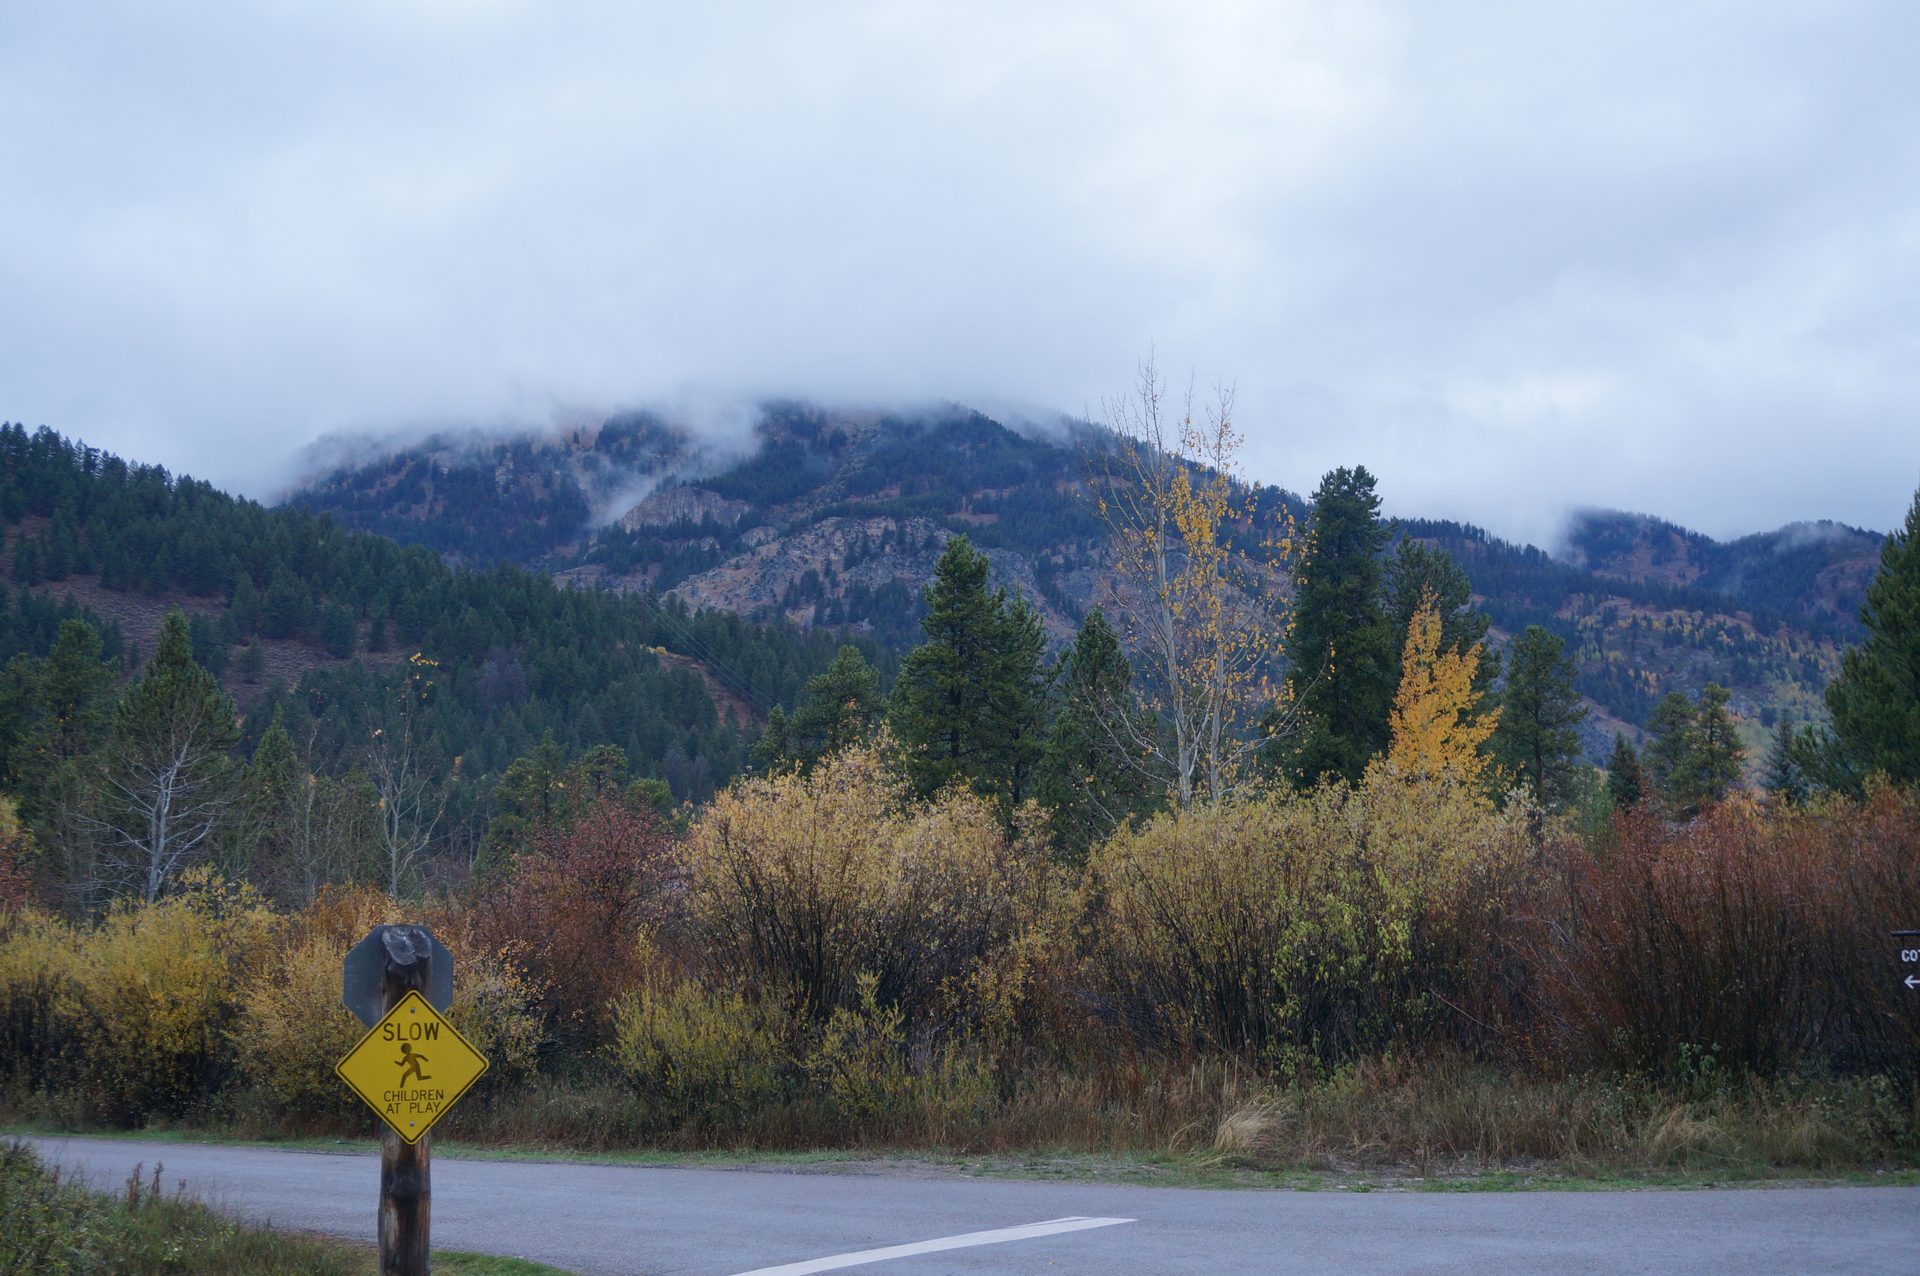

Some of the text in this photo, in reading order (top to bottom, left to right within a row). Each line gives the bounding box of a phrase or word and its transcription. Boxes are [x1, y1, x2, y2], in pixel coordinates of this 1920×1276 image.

[382, 1022, 440, 1041] SLOW
[384, 1090, 444, 1102] CHILDREN
[386, 1102, 441, 1114] AT PLAY
